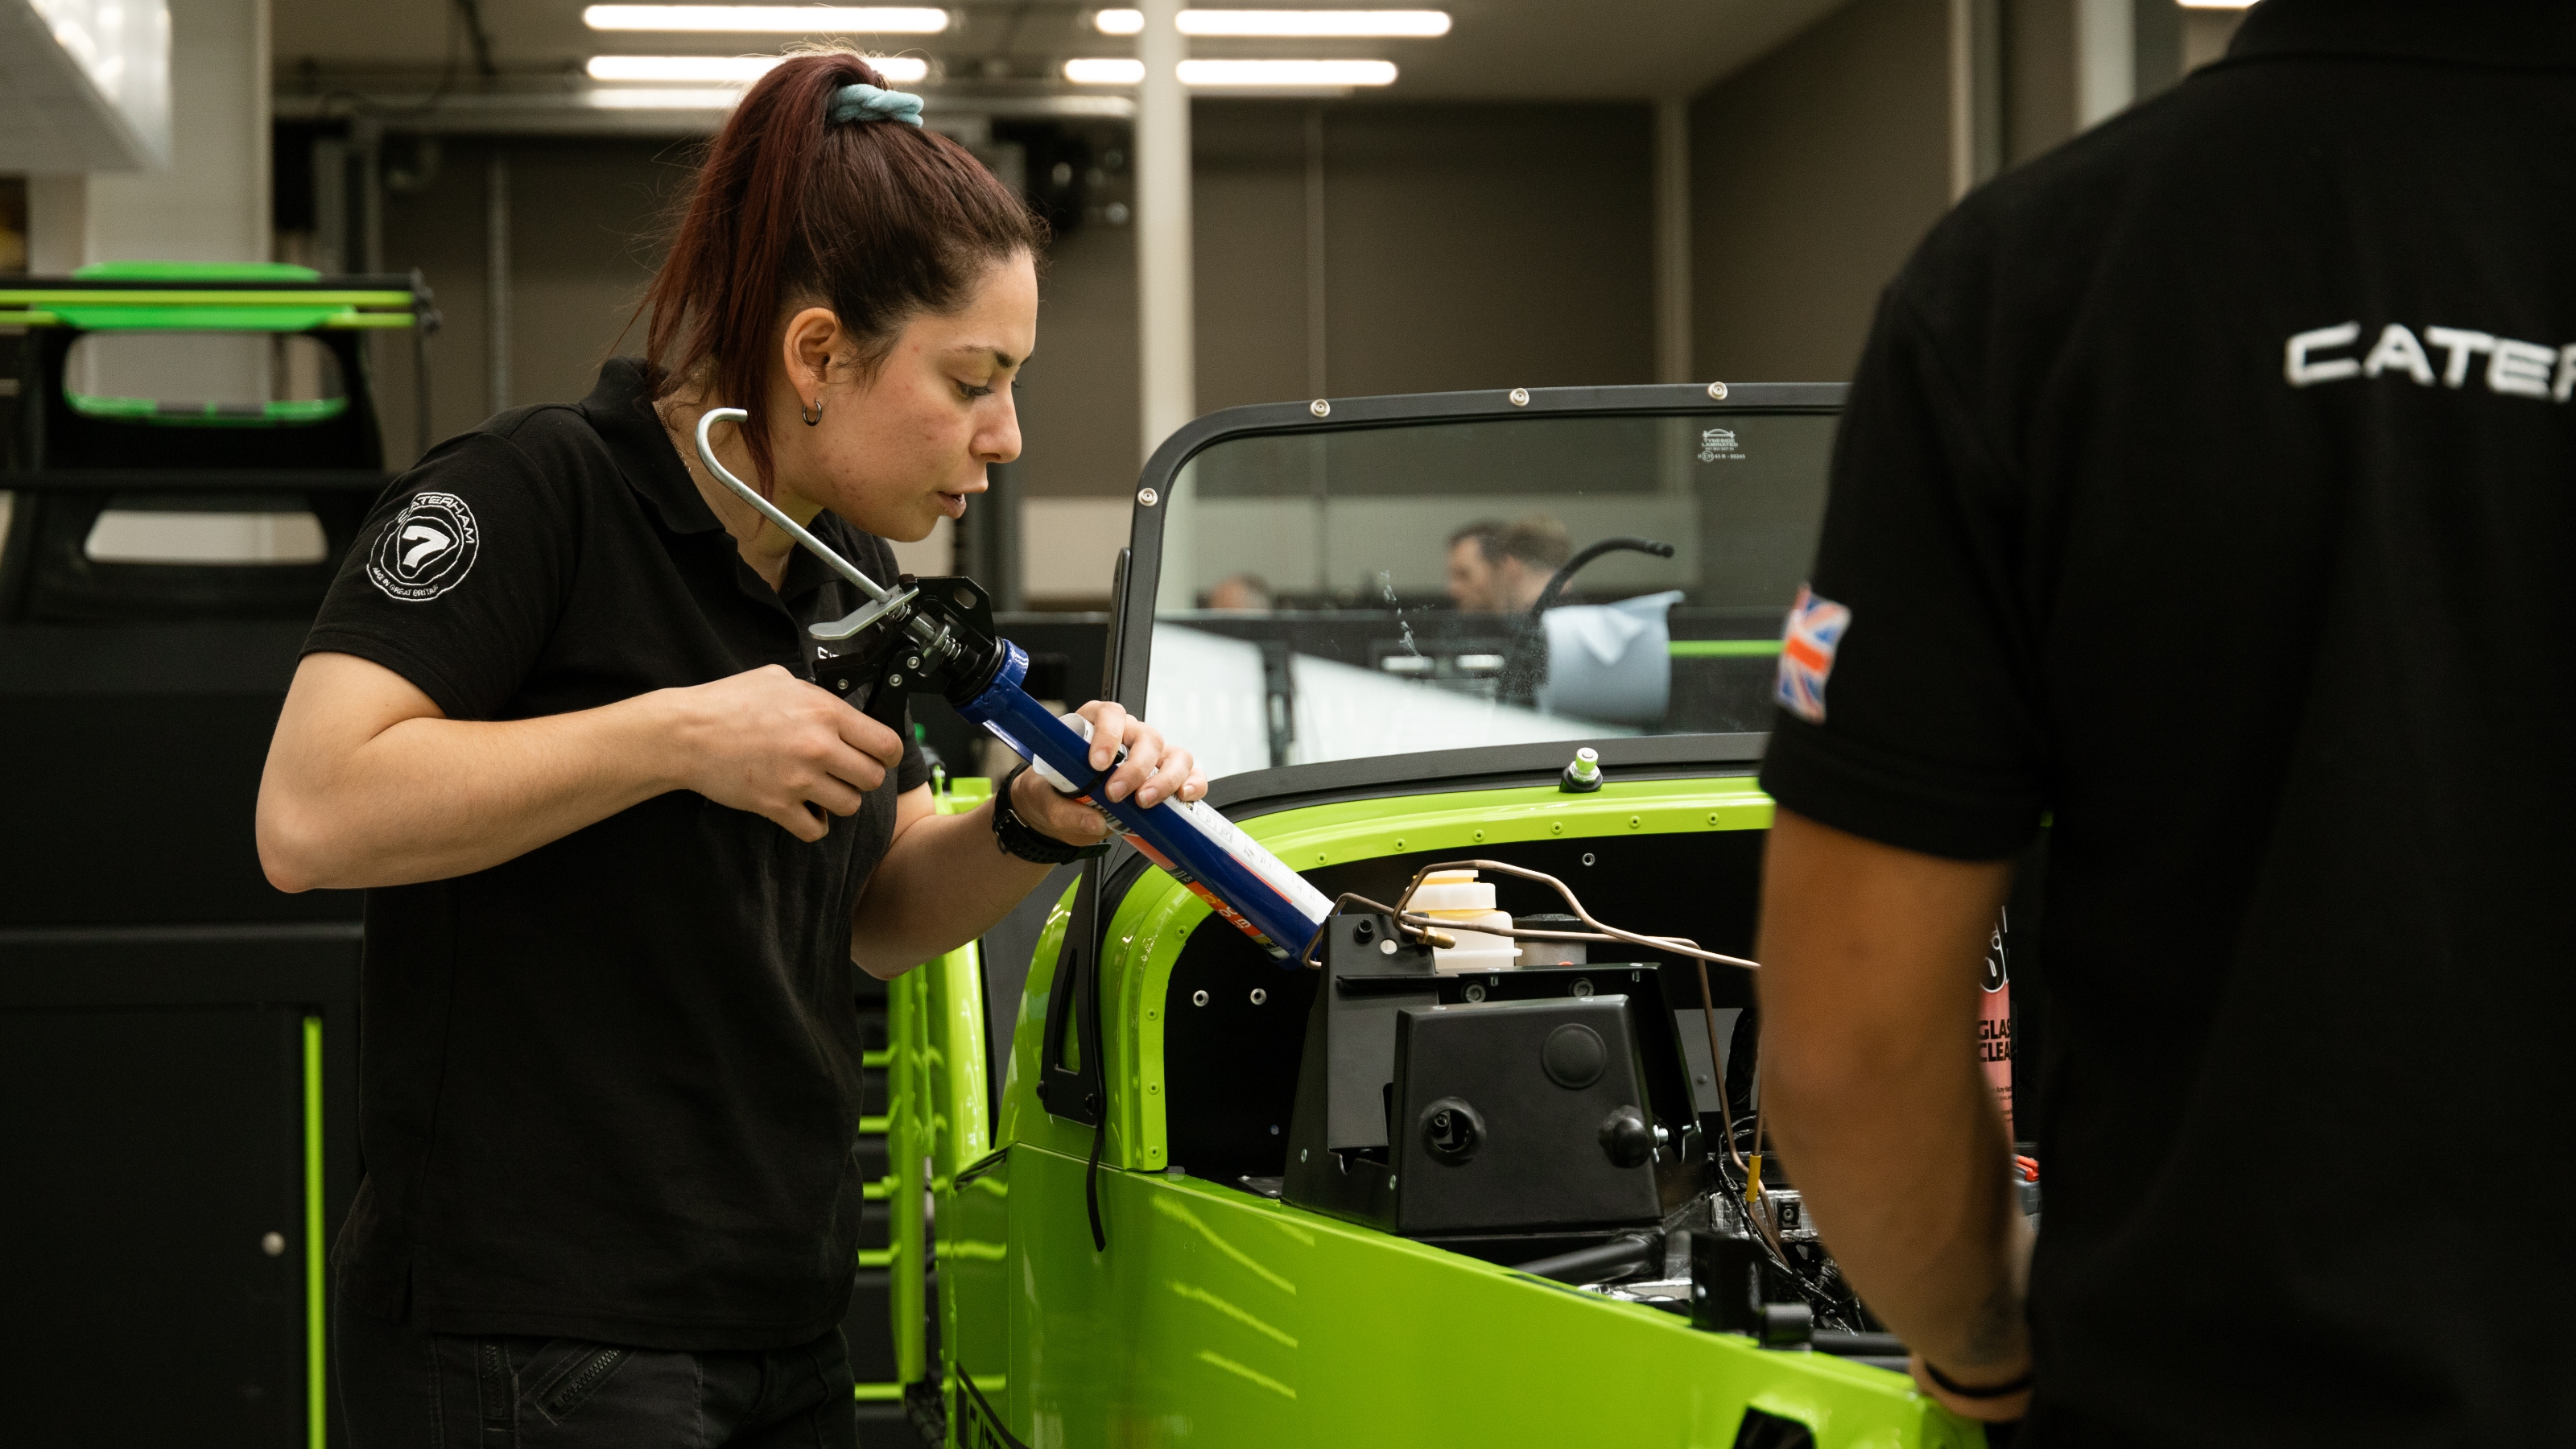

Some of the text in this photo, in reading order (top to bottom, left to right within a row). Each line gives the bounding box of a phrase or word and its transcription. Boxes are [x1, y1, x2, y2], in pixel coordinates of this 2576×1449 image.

[398, 495, 476, 544] CATERHAM
[402, 525, 451, 568] 7
[390, 584, 412, 596] GREAT
